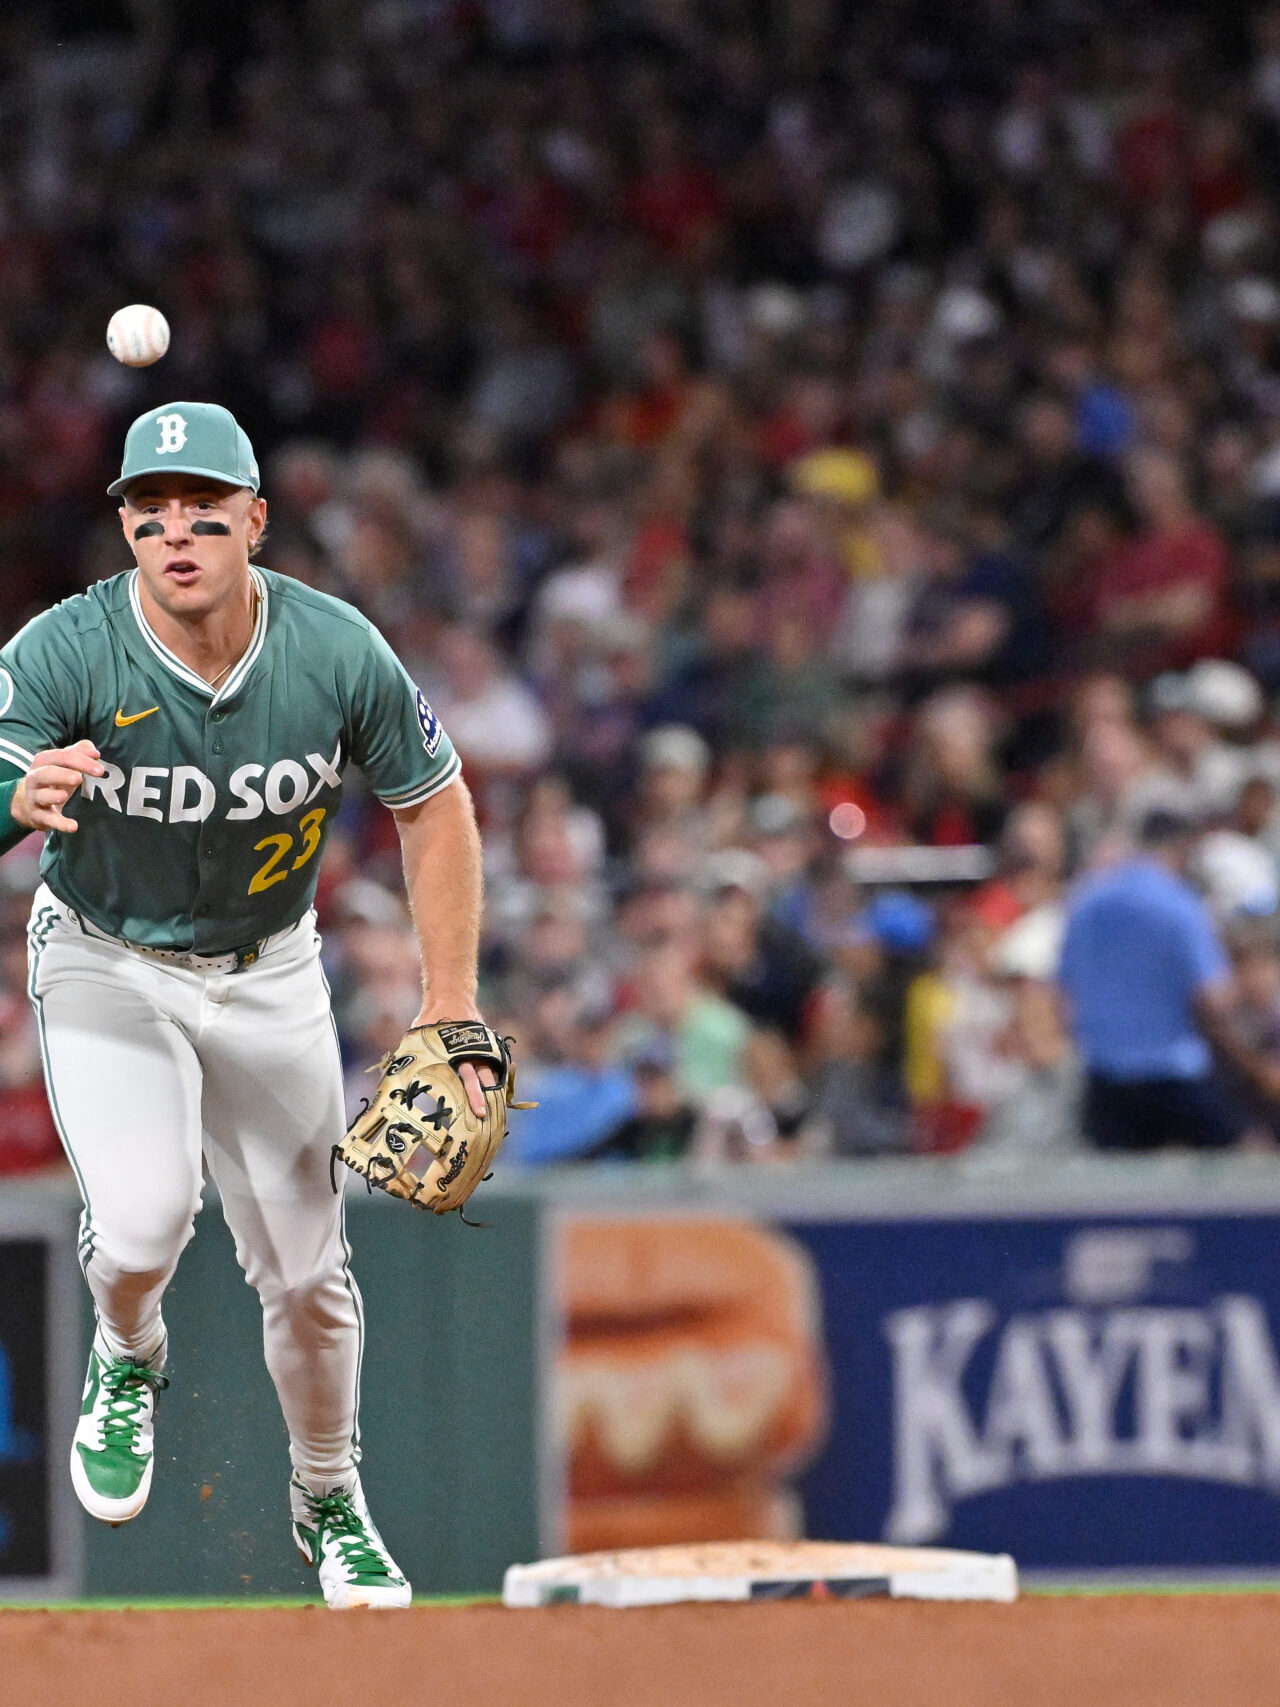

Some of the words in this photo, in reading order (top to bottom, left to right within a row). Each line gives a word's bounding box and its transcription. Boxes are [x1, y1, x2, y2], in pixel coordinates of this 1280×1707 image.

[156, 413, 188, 455] B
[80, 758, 217, 823] RED
[225, 738, 342, 820] SOX
[248, 808, 326, 896] 23
